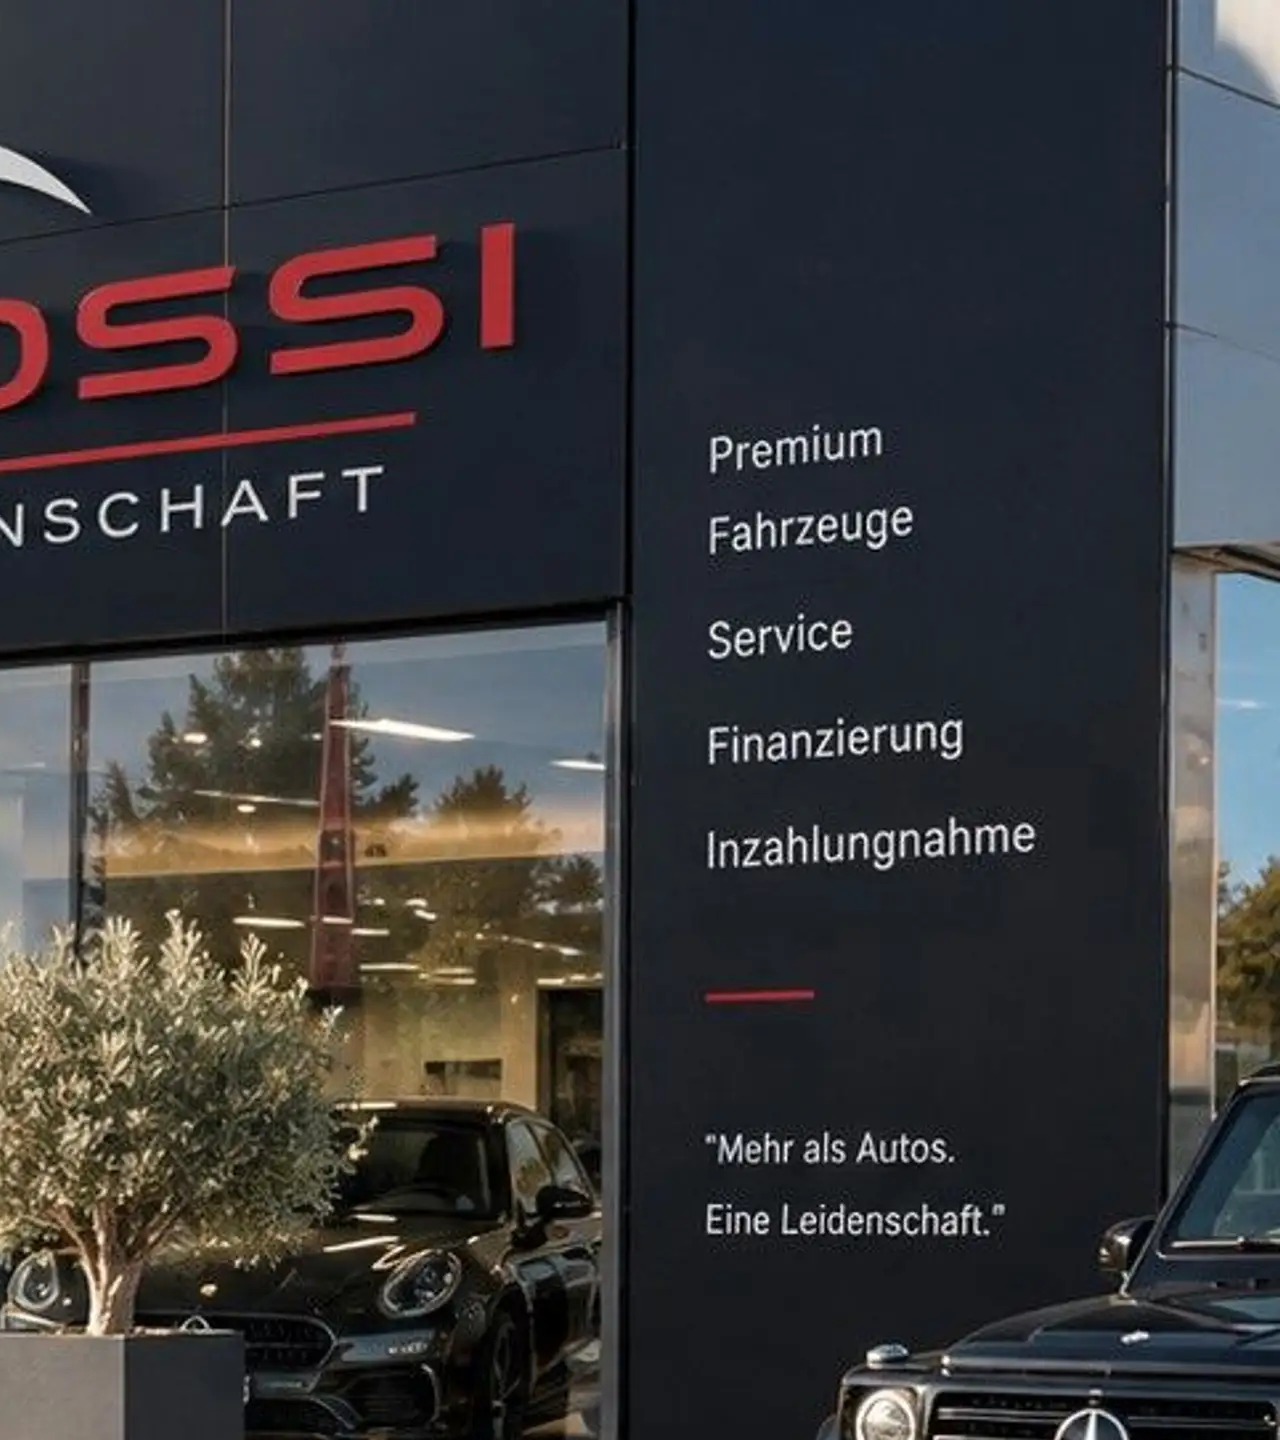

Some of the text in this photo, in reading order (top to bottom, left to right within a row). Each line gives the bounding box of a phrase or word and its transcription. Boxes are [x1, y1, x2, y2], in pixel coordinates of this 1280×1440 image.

[711, 425, 881, 472] Premium
[711, 507, 912, 554] Fahrzeuge
[709, 614, 852, 658] Service
[710, 719, 962, 764] Finanzierung
[709, 817, 1035, 870] Inzahlungnahme
[804, 1132, 845, 1163] als
[856, 1133, 954, 1162] Autos.
[707, 1204, 769, 1234] Eine
